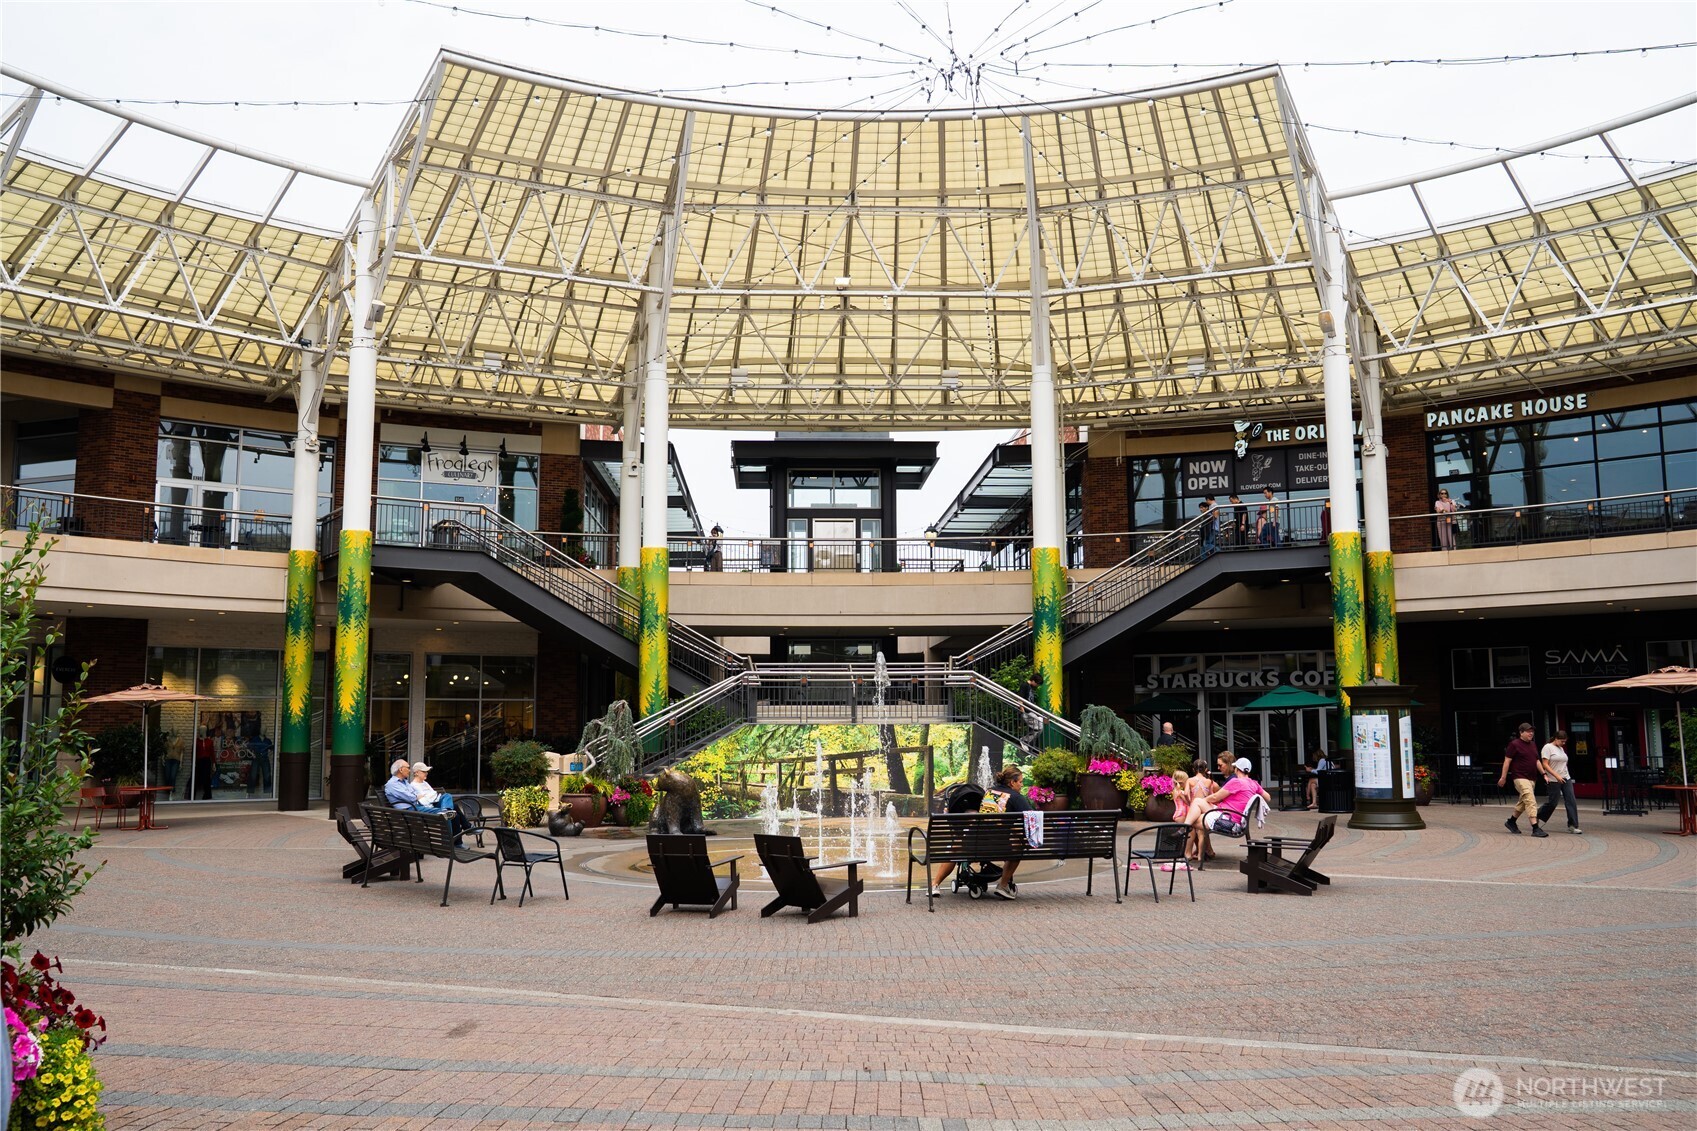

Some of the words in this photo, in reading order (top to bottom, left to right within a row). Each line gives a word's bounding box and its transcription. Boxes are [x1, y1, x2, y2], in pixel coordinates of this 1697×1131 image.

[1426, 403, 1514, 428] PANCAKE
[1521, 393, 1588, 417] HOUSE
[1265, 429, 1290, 442] THE
[1298, 451, 1328, 460] DINE-IN
[1189, 460, 1227, 475] NOW
[1294, 463, 1328, 472] TAKE-OU
[1187, 475, 1229, 491] OPEN
[1240, 482, 1282, 490] ILOVEOPHCOM
[1295, 475, 1329, 485] DELIVER
[1545, 663, 1630, 676] CELLARS
[1146, 671, 1280, 689] STARBUCKS
[1289, 670, 1335, 687] COF
[222, 739, 249, 748] BACK
